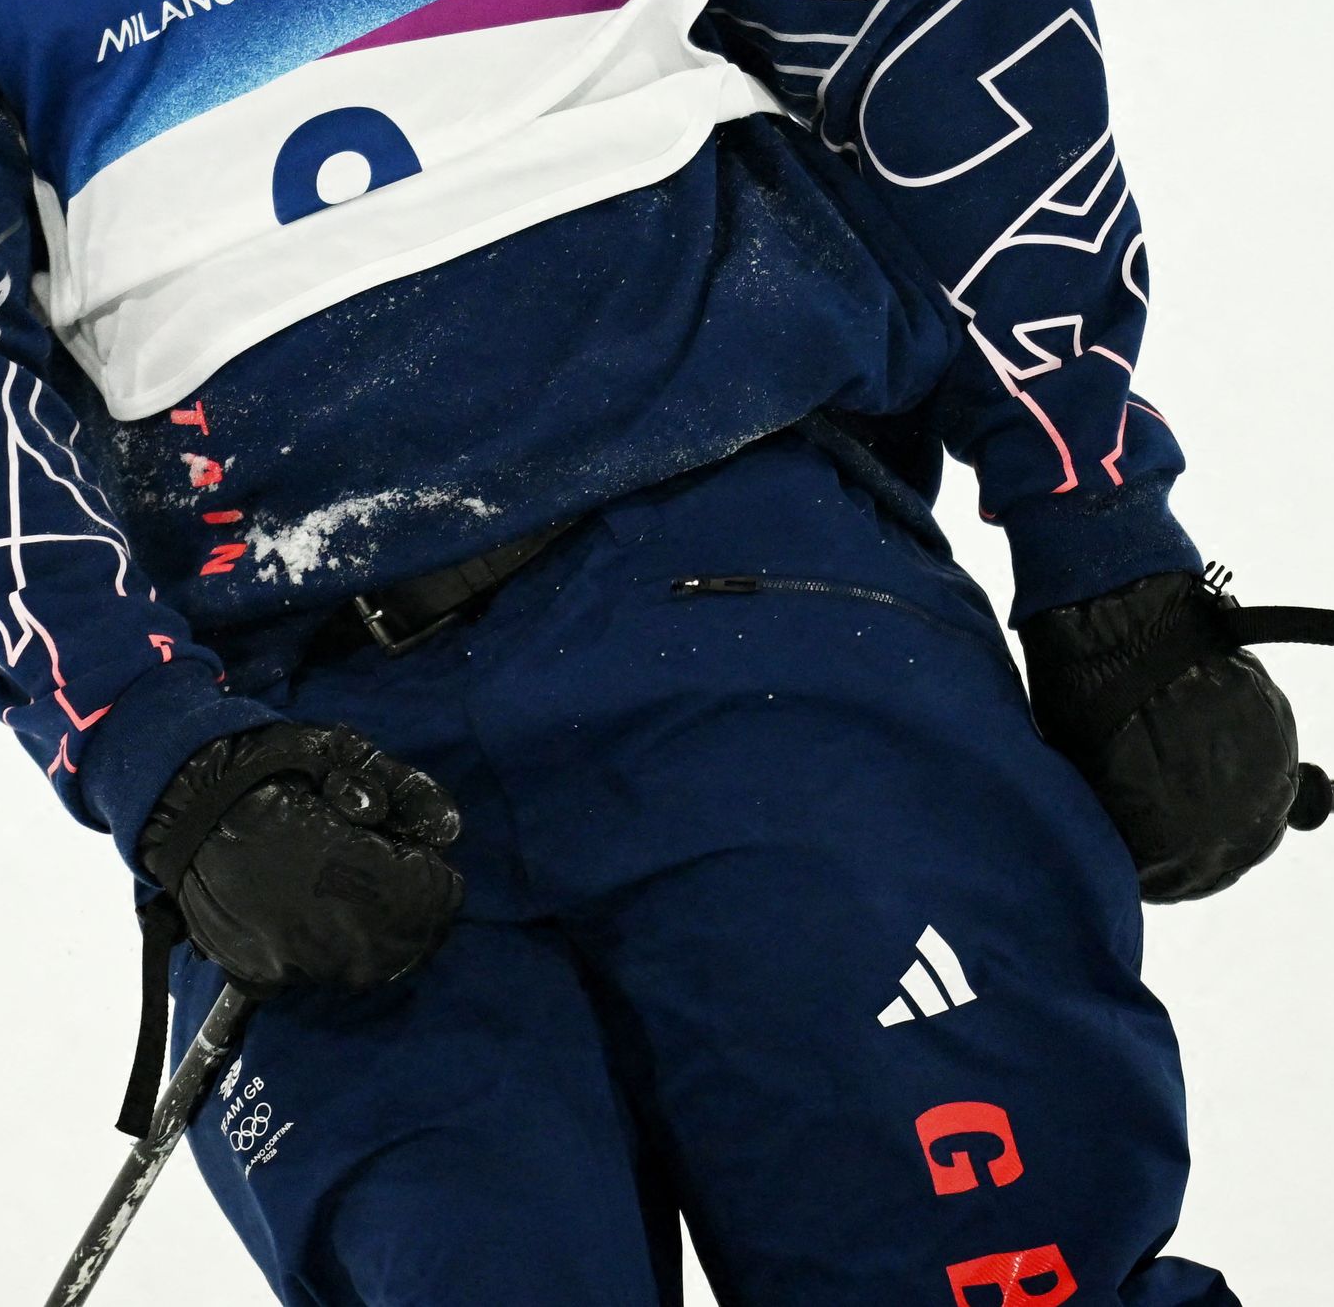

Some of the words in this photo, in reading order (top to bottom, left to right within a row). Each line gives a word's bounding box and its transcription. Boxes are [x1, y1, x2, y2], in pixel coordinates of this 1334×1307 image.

[220, 1096, 244, 1136] TEAM
[243, 1076, 265, 1100] GB
[265, 1121, 295, 1152] CORTINA
[261, 1147, 278, 1164] 2026
